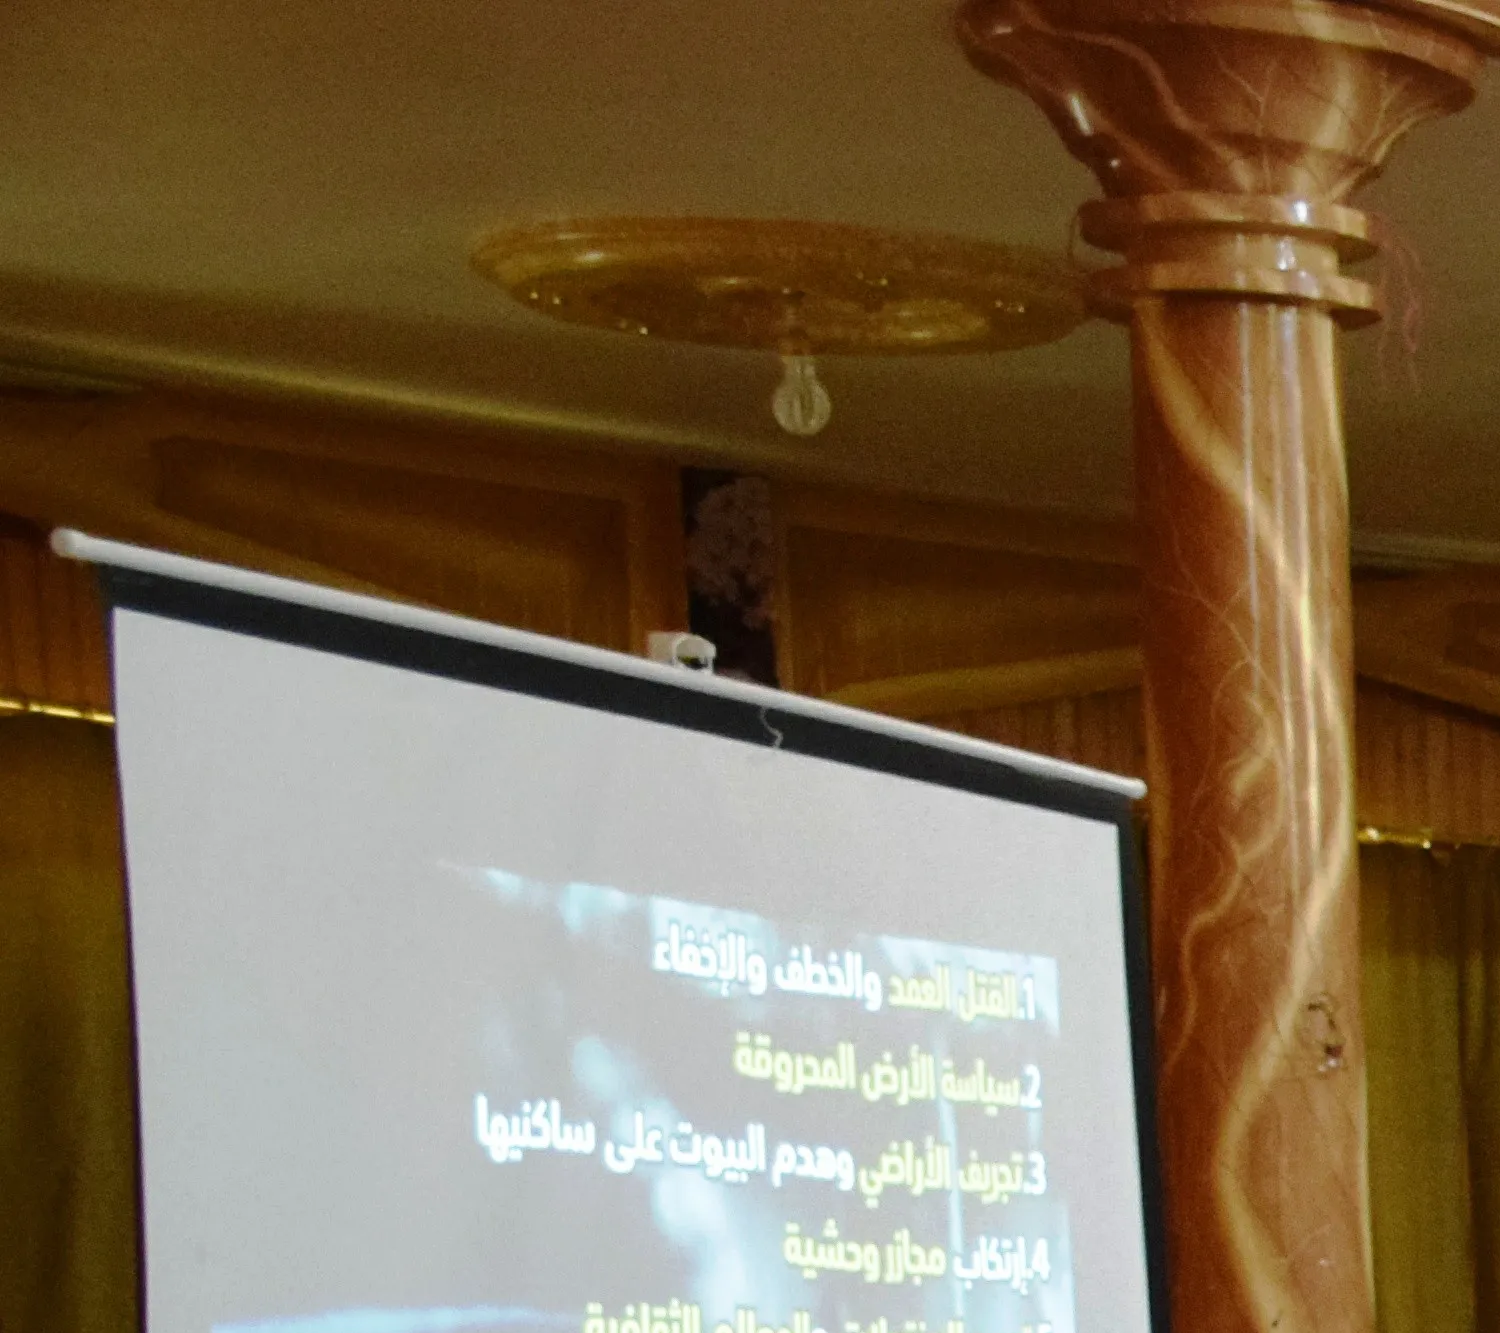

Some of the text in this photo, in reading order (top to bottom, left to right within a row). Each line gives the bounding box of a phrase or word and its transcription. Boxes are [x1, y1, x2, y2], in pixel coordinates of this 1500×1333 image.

[773, 945, 884, 1012] والخطف
[888, 964, 952, 1011] العمد
[733, 1031, 857, 1096] المحروقة
[861, 1043, 937, 1107] الأرض
[475, 1093, 596, 1163] ساكنيها
[603, 1111, 663, 1173] على
[668, 1120, 766, 1184] البيوت
[771, 1142, 855, 1190] وهدم
[858, 1137, 953, 1207] الأراضي
